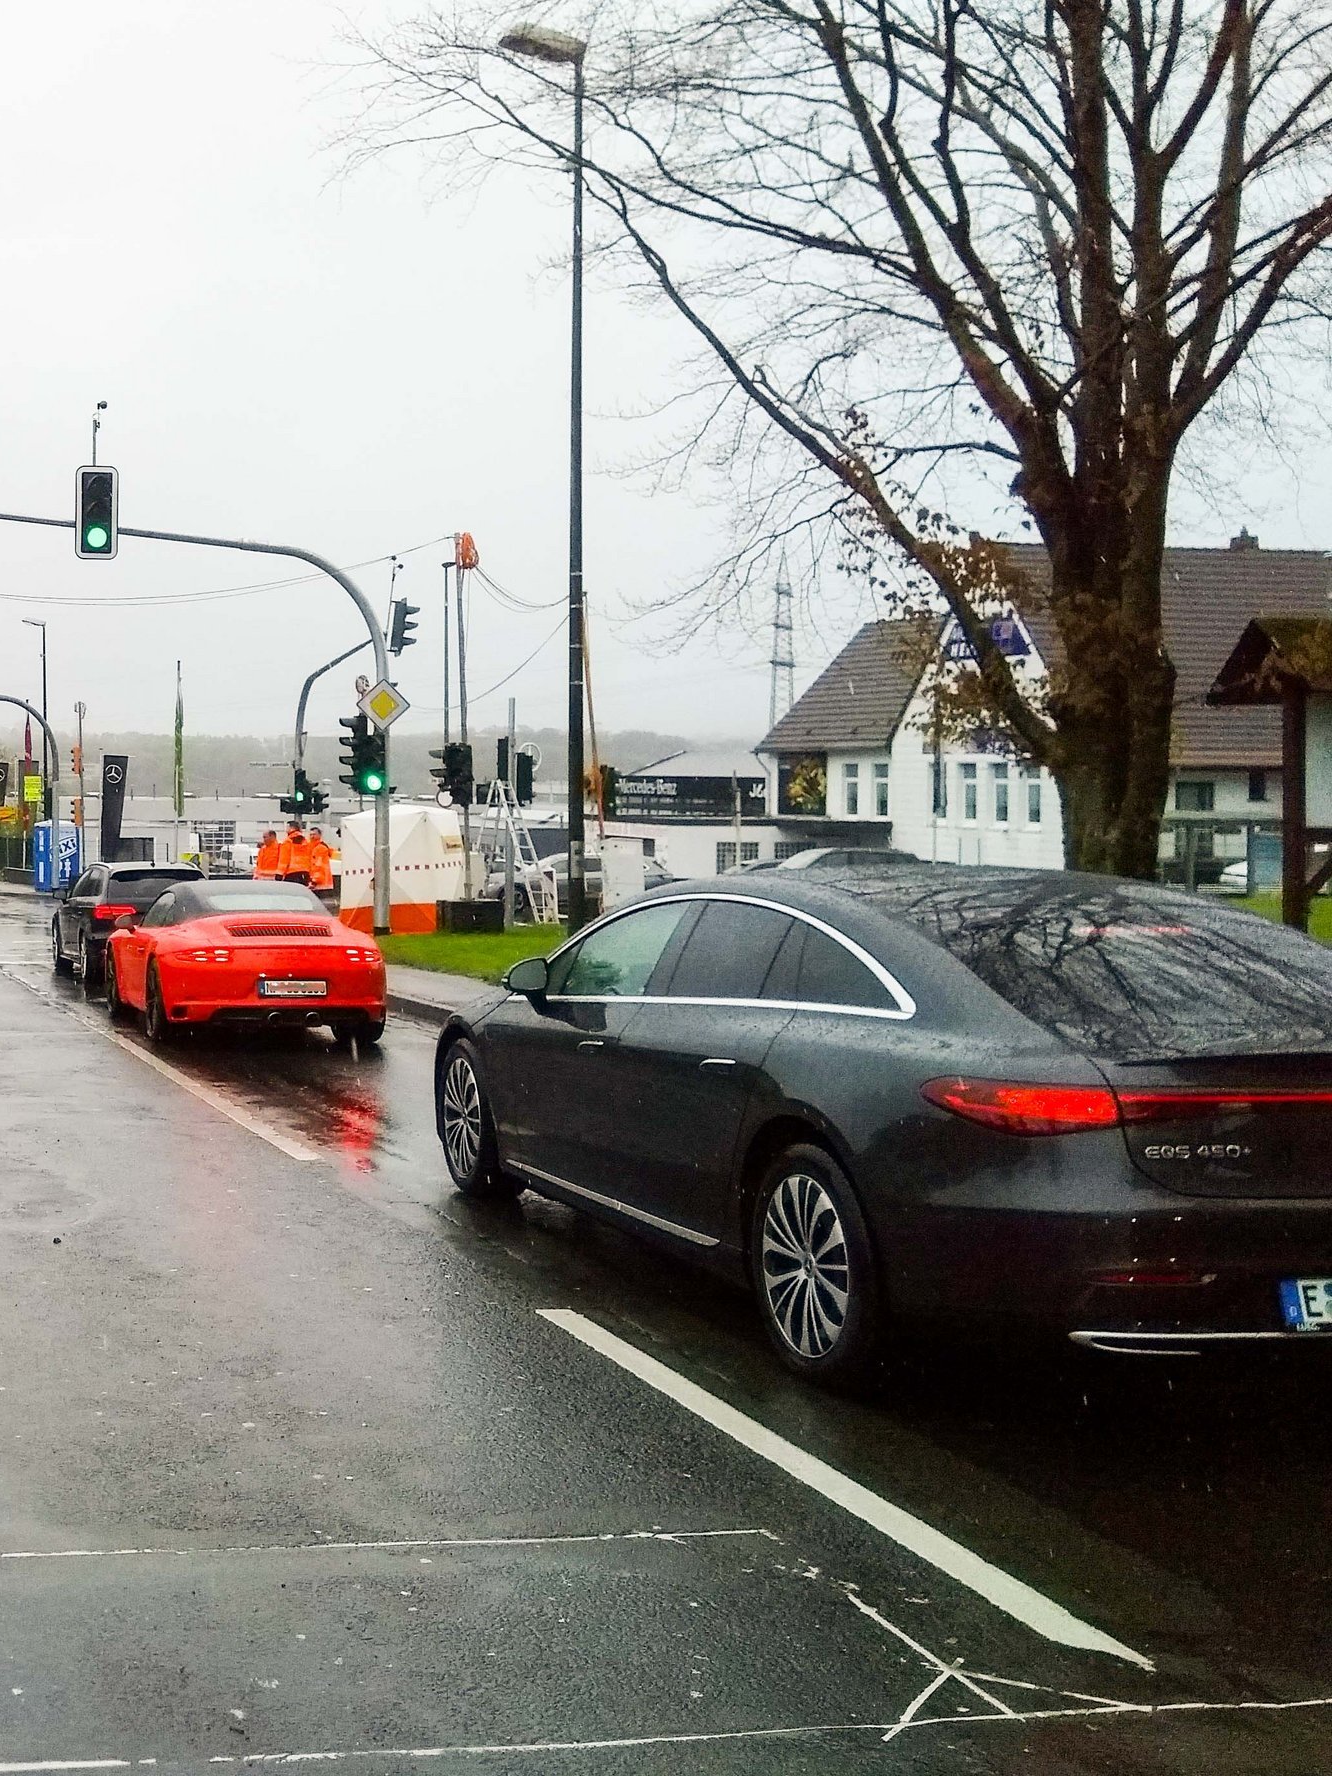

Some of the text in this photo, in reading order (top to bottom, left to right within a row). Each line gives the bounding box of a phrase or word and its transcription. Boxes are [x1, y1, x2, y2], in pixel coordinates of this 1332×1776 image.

[617, 778, 677, 796] Mercedes-Benz
[1145, 1145, 1252, 1159] EQS 450+
